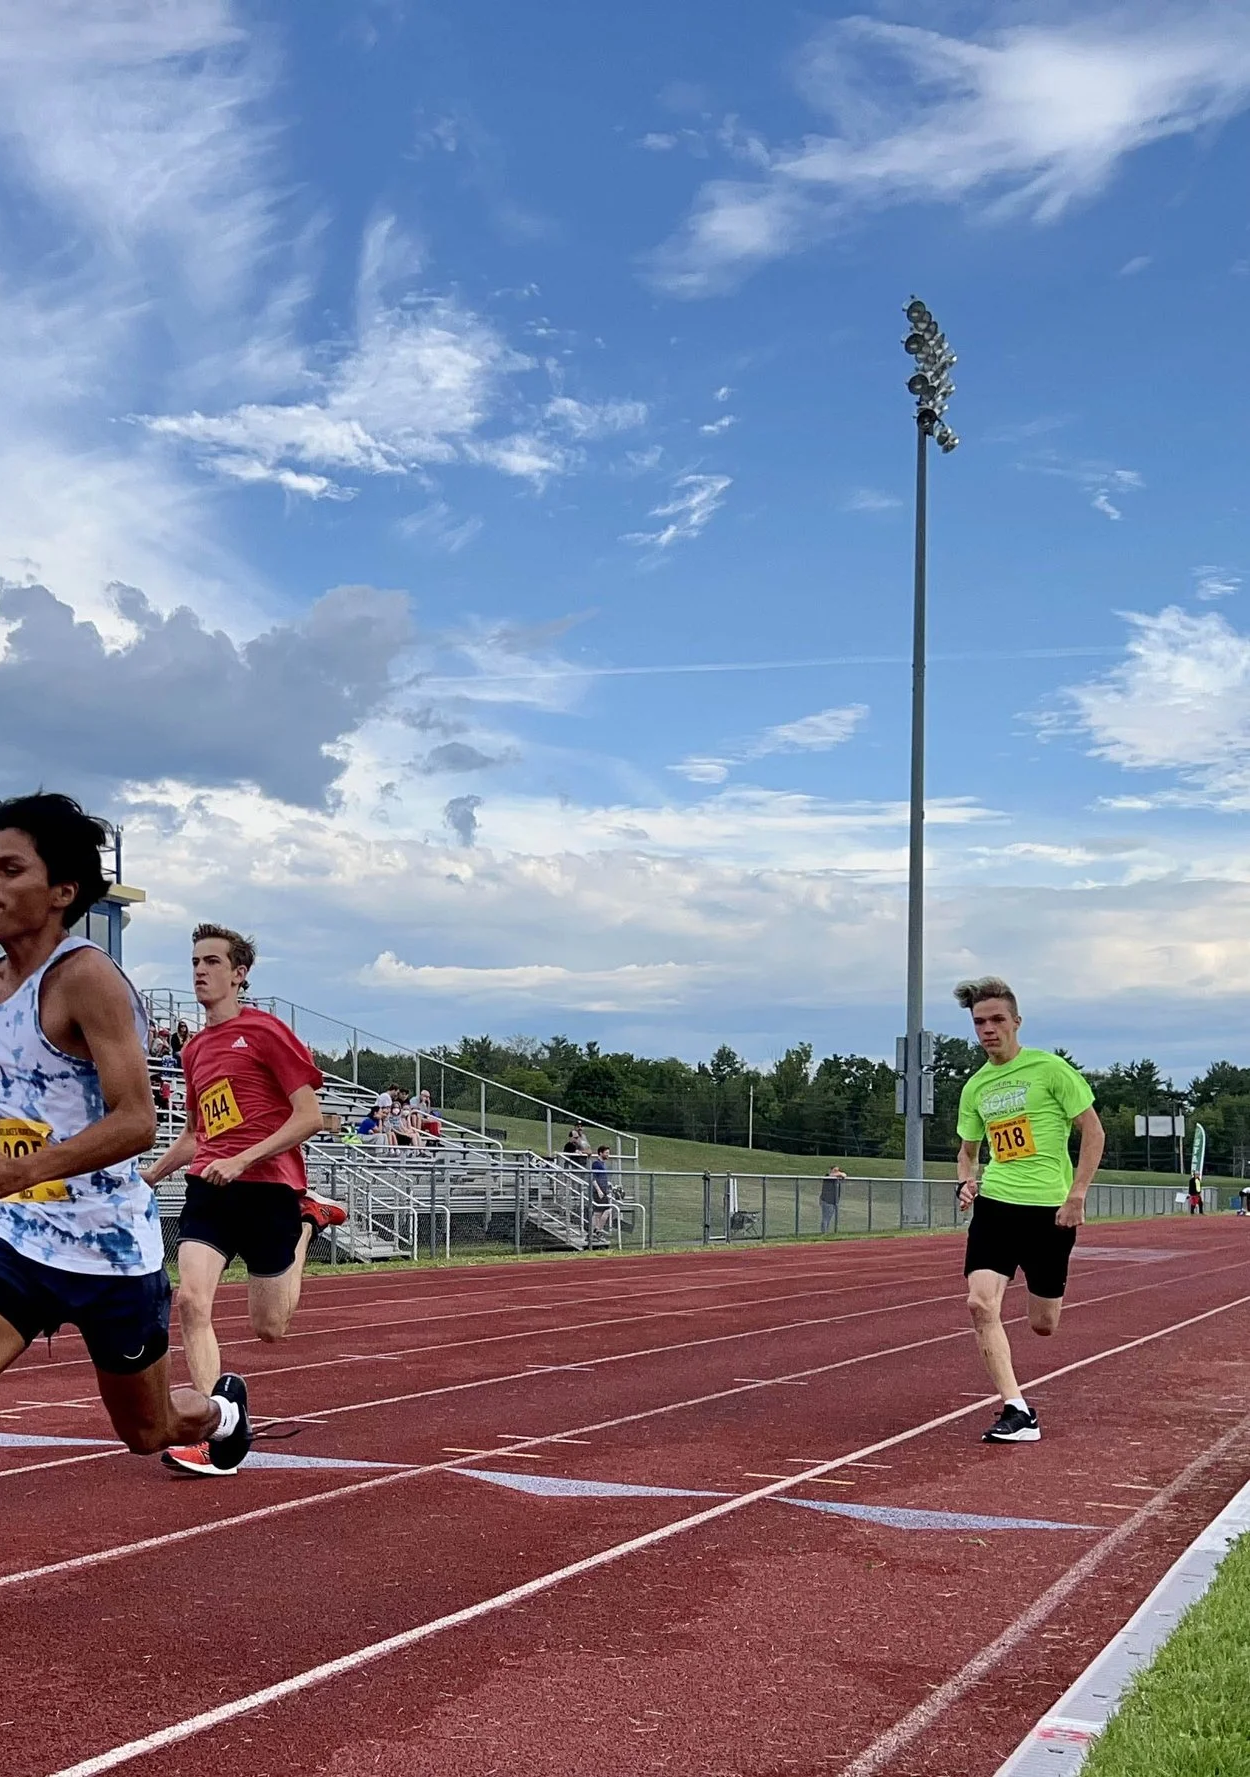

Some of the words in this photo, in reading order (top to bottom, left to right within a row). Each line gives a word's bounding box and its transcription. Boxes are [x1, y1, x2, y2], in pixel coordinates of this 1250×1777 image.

[204, 1093, 230, 1127] 244
[981, 1089, 1026, 1111] SOAR
[994, 1126, 1025, 1152] 218
